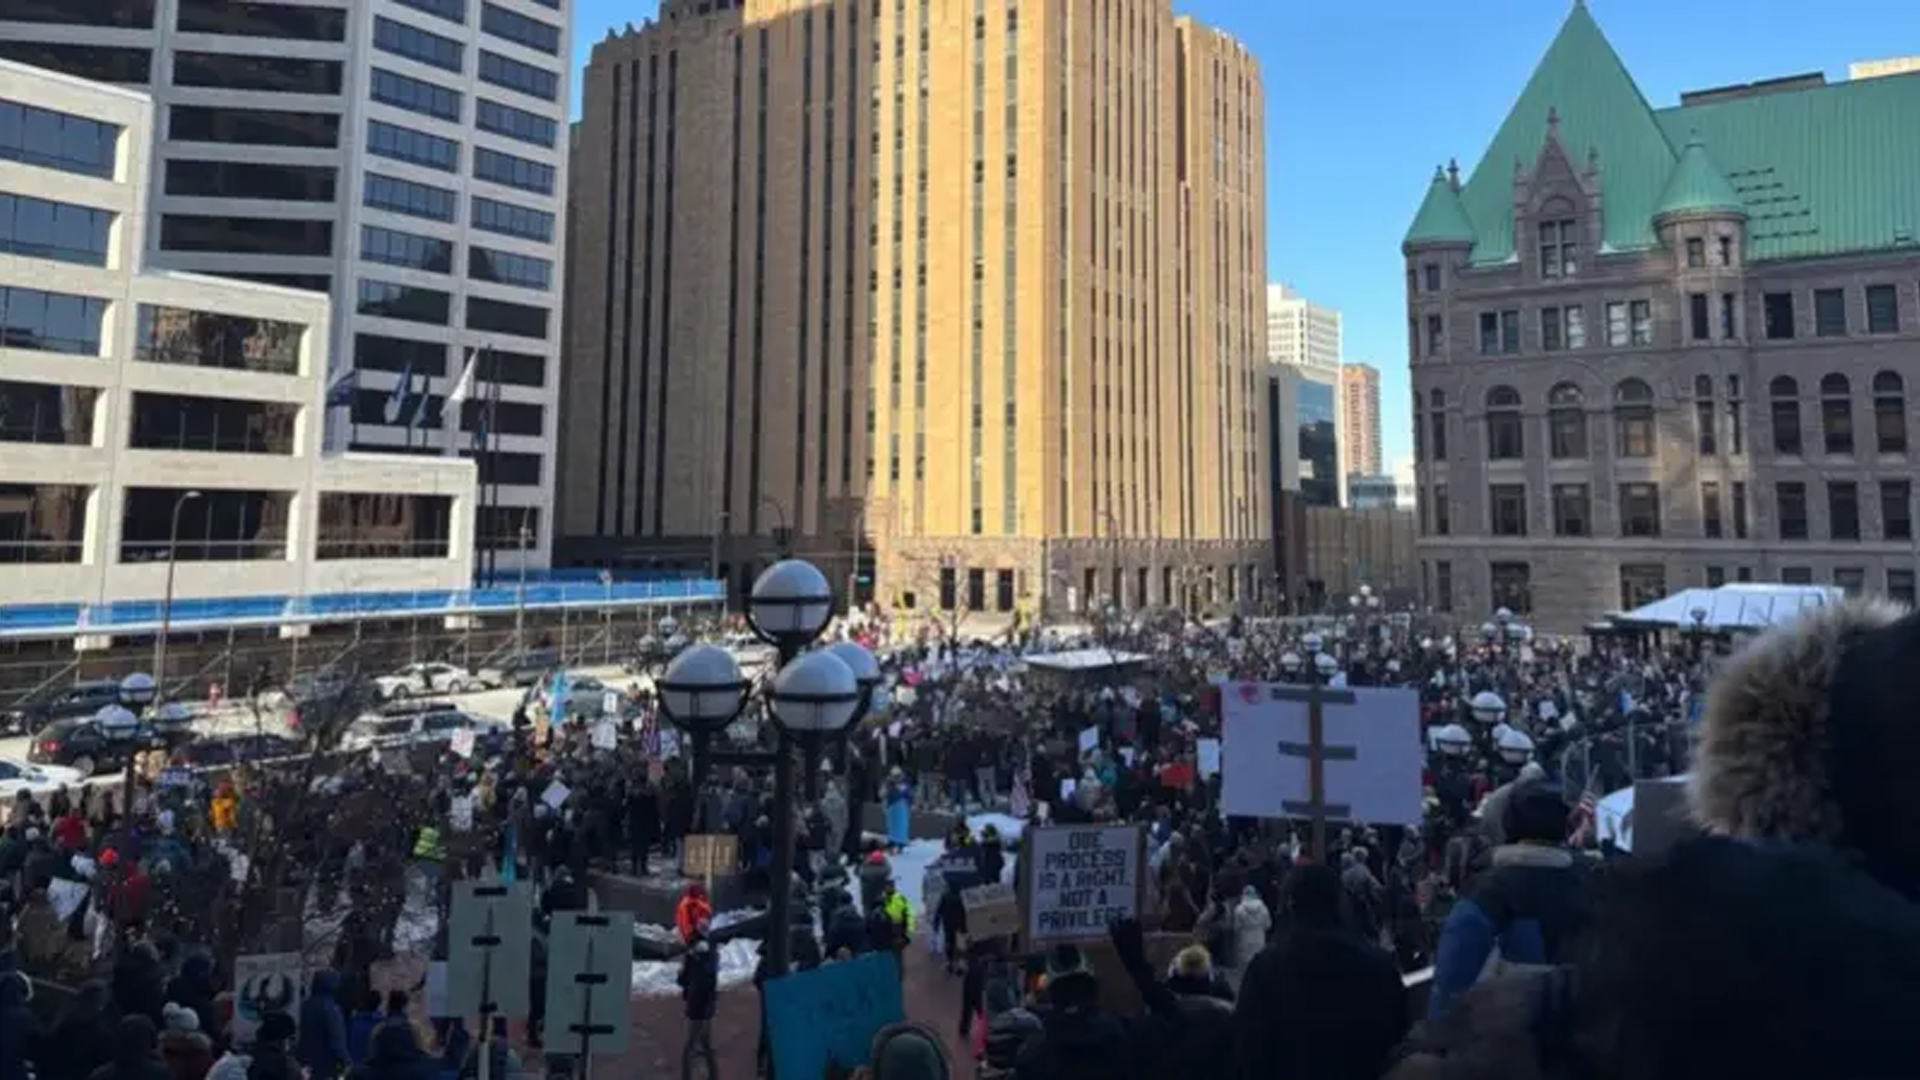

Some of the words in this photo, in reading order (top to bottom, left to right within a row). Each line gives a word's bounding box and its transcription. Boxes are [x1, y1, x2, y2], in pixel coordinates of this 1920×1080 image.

[1069, 831, 1103, 850] DUE
[1045, 849, 1126, 869] PROCESS
[1039, 872, 1056, 890] IS
[1060, 872, 1071, 888] A
[1060, 889, 1093, 907] NOT
[1098, 889, 1108, 905] A
